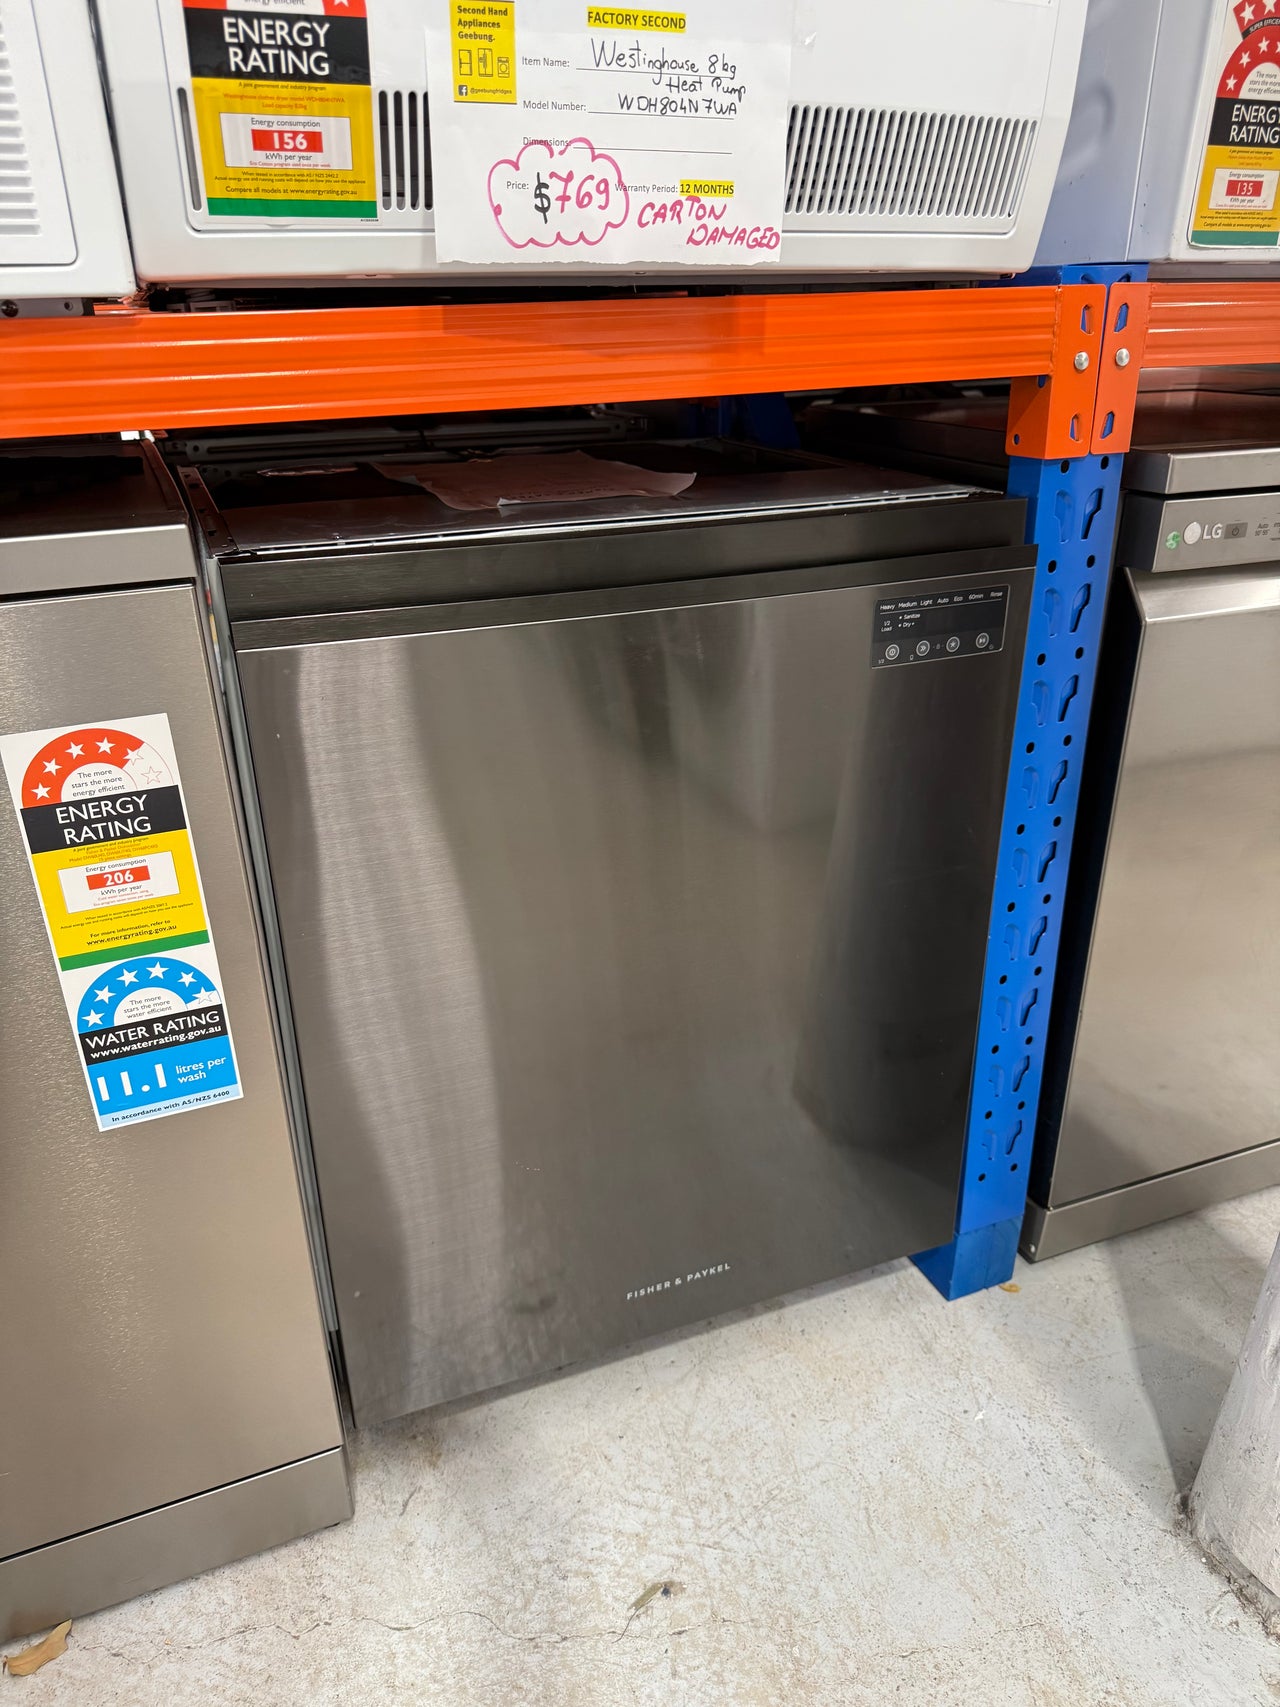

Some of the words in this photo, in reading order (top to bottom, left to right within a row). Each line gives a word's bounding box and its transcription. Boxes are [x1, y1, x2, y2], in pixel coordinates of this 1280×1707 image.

[457, 5, 486, 16] Second
[488, 7, 508, 16] Hand
[458, 18, 500, 29] Appliances
[588, 11, 638, 28] FACTORY
[642, 15, 686, 30] SECOND
[223, 17, 330, 47] ENERGY
[458, 31, 496, 43] Geebung.
[228, 47, 330, 76] RATING
[522, 56, 541, 66] Item
[543, 57, 570, 68] Name:
[591, 38, 699, 85] Westinghouse
[666, 76, 702, 94] Heat
[712, 77, 746, 103] Pump
[523, 101, 549, 110] Model
[551, 101, 587, 112] Number:
[251, 117, 275, 127] Energy
[276, 119, 321, 128] consumption
[274, 132, 308, 150] 156
[523, 137, 572, 147] Dimensions:
[1229, 125, 1280, 144] RATING
[284, 154, 296, 162] per
[298, 154, 312, 162] year
[226, 186, 252, 194] Compare
[290, 188, 358, 196] www.energyrating.gov.au
[506, 181, 529, 190] Price:
[615, 184, 650, 193] Warranty
[652, 184, 678, 193] Period:
[680, 184, 691, 194] 12
[693, 184, 734, 195] MONTHS
[1237, 182, 1254, 195] 135
[534, 170, 610, 224] $769
[637, 195, 727, 228] CARTON
[686, 224, 780, 250] DAMAGED
[1202, 523, 1223, 540] LG
[920, 599, 933, 607] Light
[98, 784, 126, 793] efficient
[56, 794, 148, 825] ENERGY
[64, 816, 152, 845] RATING
[108, 858, 146, 869] consumption
[104, 870, 134, 886] 206
[87, 925, 177, 946] www.energyrating.gov.au
[117, 923, 150, 934] information,
[127, 1011, 146, 1019] water
[147, 1006, 172, 1015] efficient
[85, 1025, 150, 1049] WATER
[153, 1010, 221, 1035] RATING
[91, 1025, 222, 1060] www.waterrating.gov.au
[175, 1062, 204, 1075] litres
[208, 1056, 227, 1072] per
[97, 1064, 167, 1102] 11.1
[178, 1071, 207, 1084] wash
[121, 1106, 162, 1121] accordance
[164, 1101, 180, 1110] with
[182, 1094, 212, 1106] AS/NZS
[213, 1090, 230, 1099] 6400
[627, 1281, 671, 1300] FISHER
[687, 1263, 731, 1282] PAYKEL
